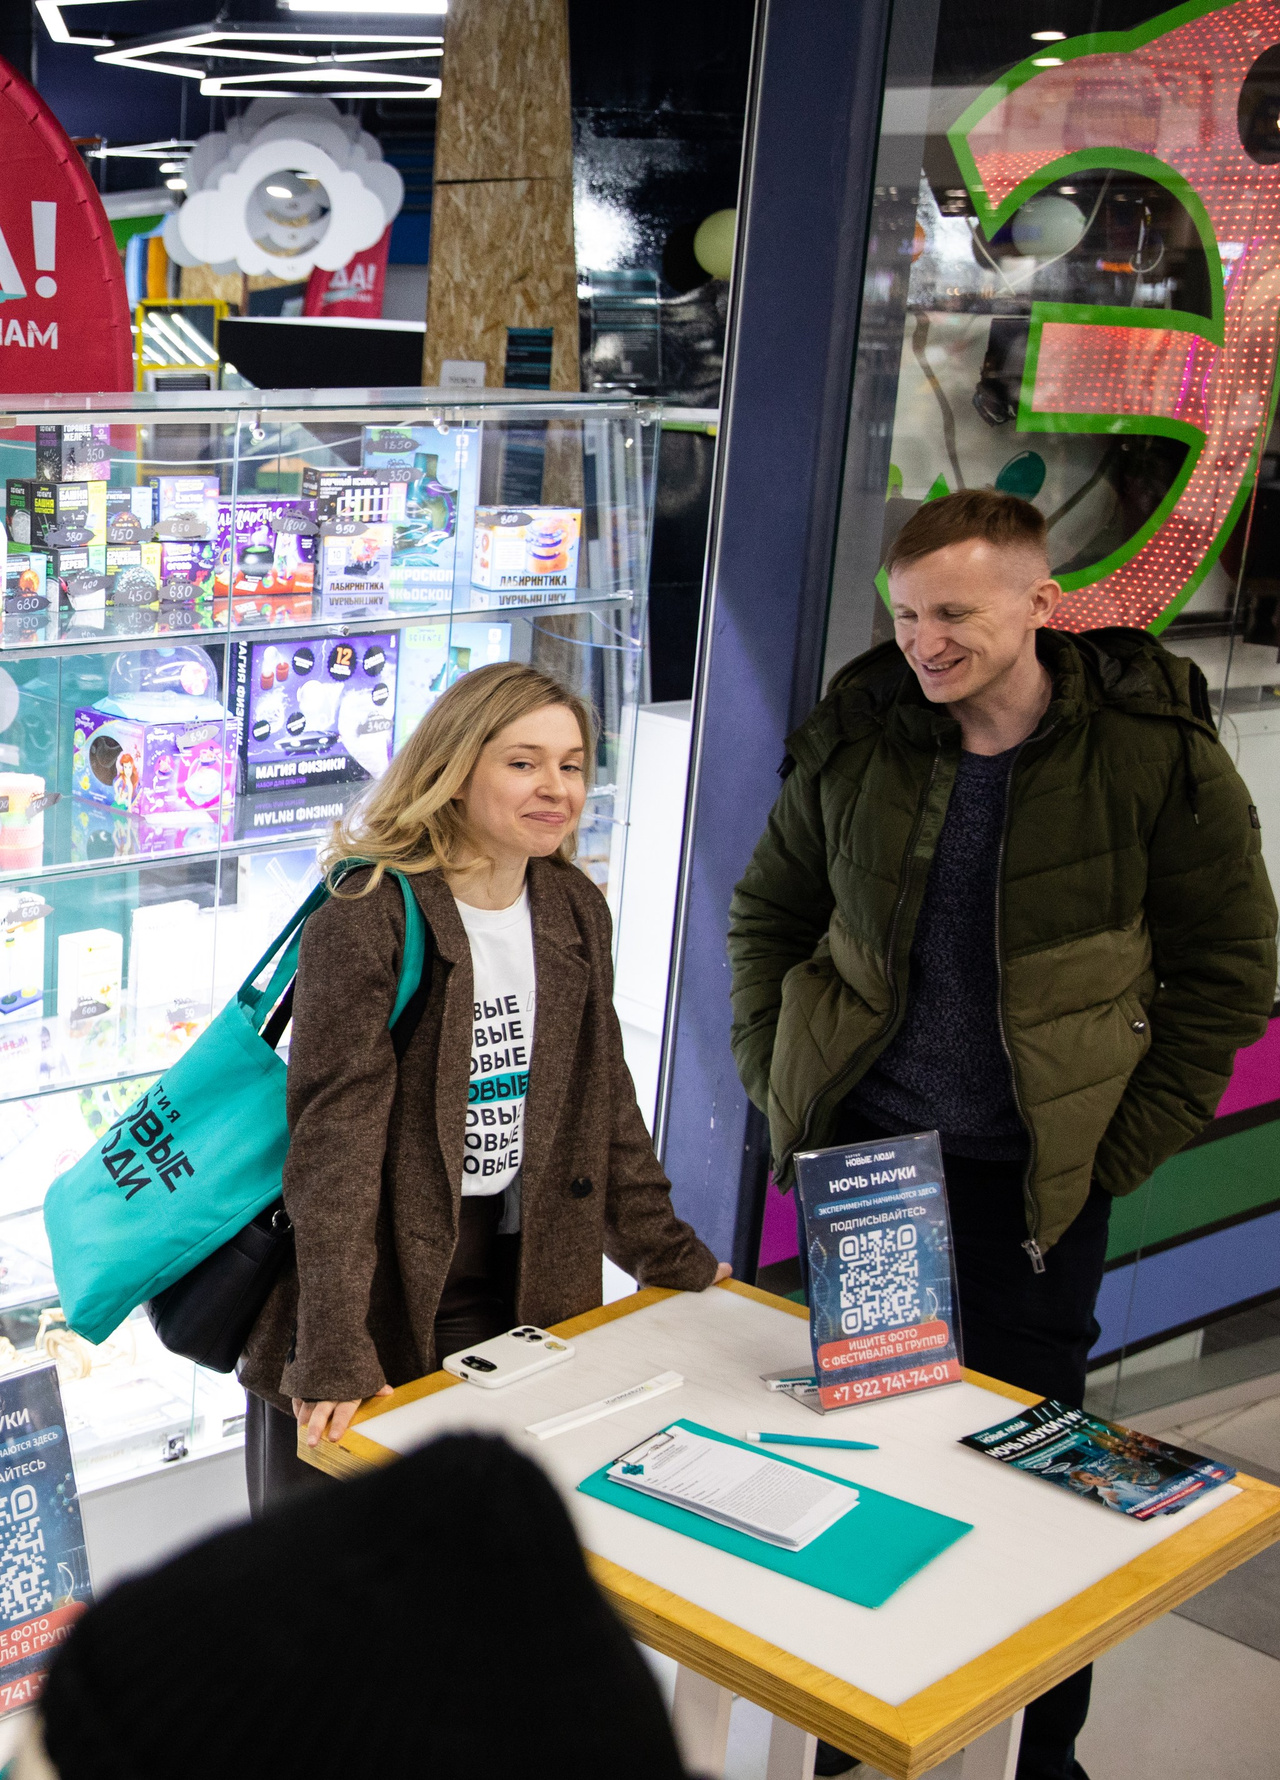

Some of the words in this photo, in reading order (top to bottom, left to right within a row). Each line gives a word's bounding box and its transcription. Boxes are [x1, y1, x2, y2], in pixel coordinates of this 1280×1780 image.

[87, 448, 104, 461] 350
[389, 470, 411, 481] 350
[283, 520, 307, 531] 1800
[65, 532, 83, 542] 380
[110, 528, 134, 540] 450
[389, 569, 453, 581] ИКРОСКОП
[499, 575, 567, 587] ЛАБИРИНТИКА
[82, 580, 98, 590] 400
[169, 585, 193, 598] 680
[329, 581, 384, 591] ЛАБИРИНТИКА
[128, 590, 152, 602] 450
[17, 598, 39, 610] 680
[336, 647, 352, 666] 12
[255, 763, 296, 779] МАГИЯ
[298, 756, 346, 774] ФИЗИКИ
[22, 905, 40, 917] 650
[468, 1073, 530, 1102] ОВЫЕ
[464, 1126, 519, 1152] ОВЫЕ
[463, 1149, 519, 1177] ОВЫЕ
[829, 1174, 868, 1193] НОЧЬ
[870, 1165, 916, 1186] НАУКИ
[818, 1198, 872, 1216] ЭКСПЕРИМЕНТЫ
[873, 1190, 916, 1206] НАЧИНАЮТСЯ
[917, 1186, 937, 1198] ЗДЕСЬ
[830, 1206, 926, 1233] ПОДПИСЫВАЙТЕСЬ
[849, 1336, 886, 1352] ИЩИТЕ
[887, 1328, 917, 1343] ФОТО
[822, 1358, 830, 1368] С
[831, 1345, 894, 1367] ФЕСТИВАЛЯ
[896, 1343, 903, 1353] В
[905, 1334, 945, 1352] ГРУППЕ!
[833, 1386, 850, 1401] +7
[853, 1380, 881, 1398] 922
[883, 1364, 949, 1391] 741-74-01
[32, 1431, 58, 1447] ЗДЕСЬ
[984, 1441, 1025, 1458] НОЧЬ
[10, 1618, 49, 1642] ФОТО
[21, 1640, 30, 1653] В
